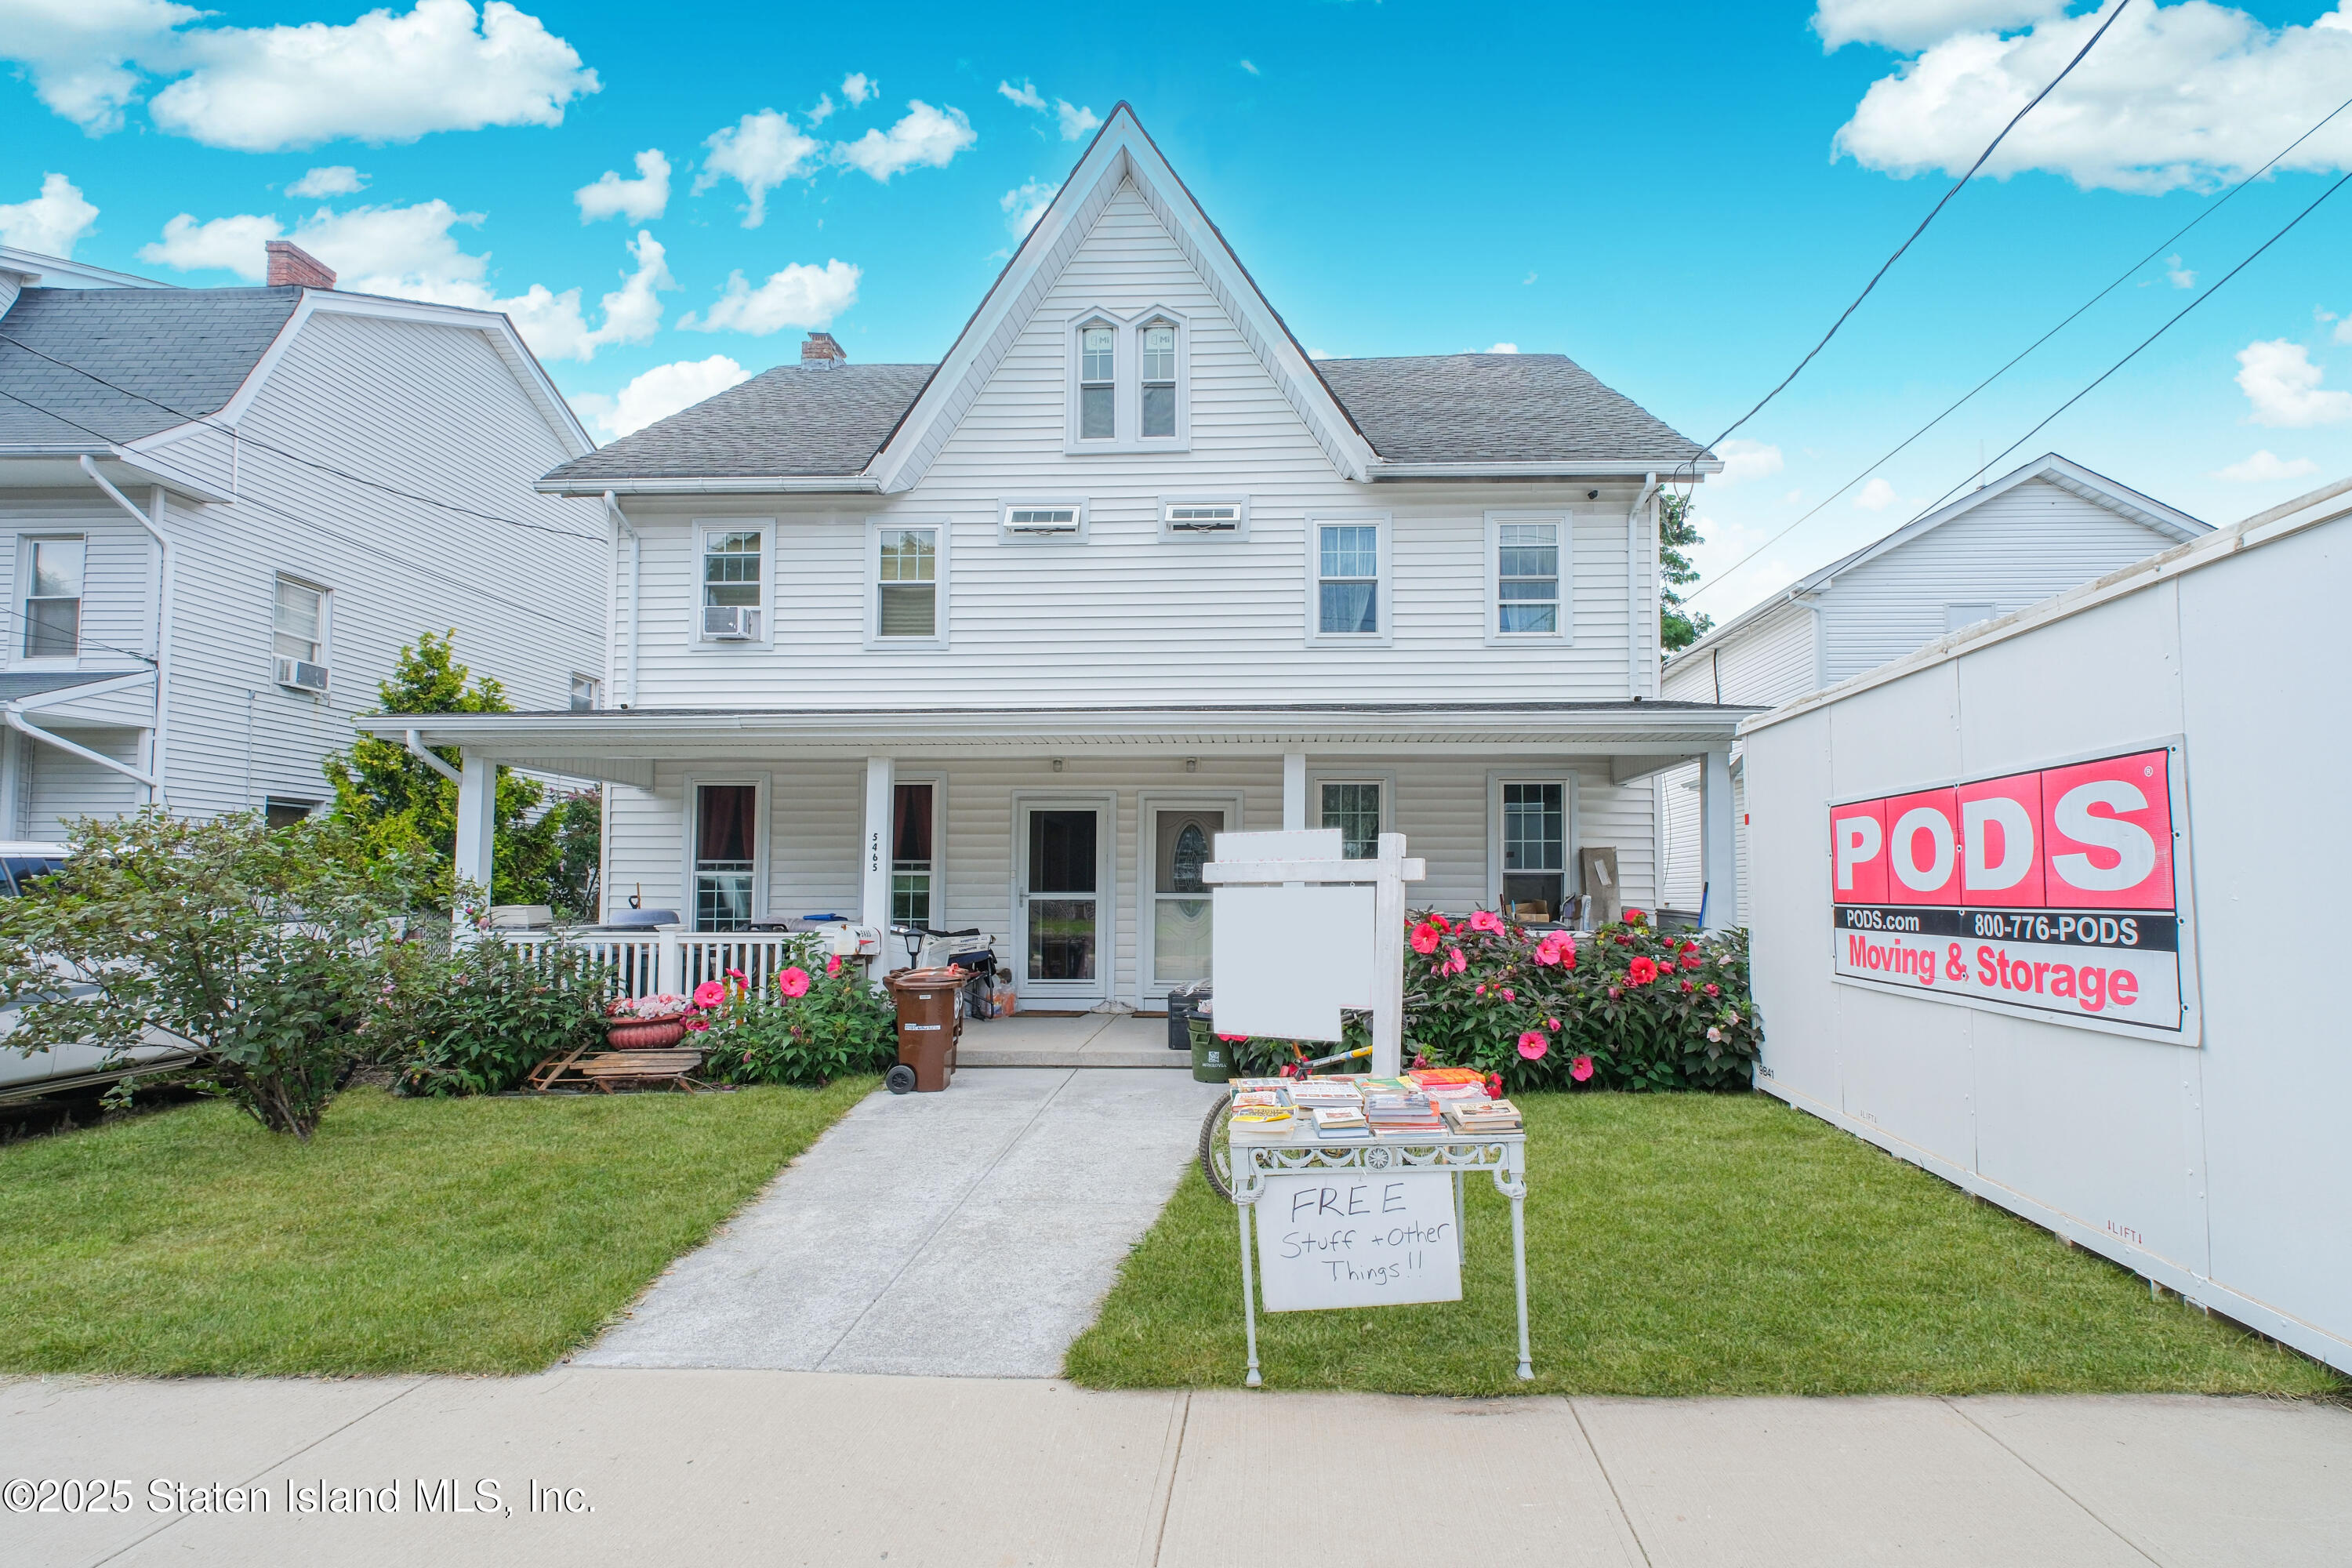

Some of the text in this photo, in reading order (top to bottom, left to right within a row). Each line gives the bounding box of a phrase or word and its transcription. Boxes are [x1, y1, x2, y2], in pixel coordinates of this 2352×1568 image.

[1835, 780, 2156, 891] PODS
[1846, 909, 2139, 946] PODS.com 800-776-PODS
[1849, 934, 2139, 1011] Moving & Storage
[1291, 1182, 1406, 1223] FREE
[1279, 1229, 1356, 1259] Stuff
